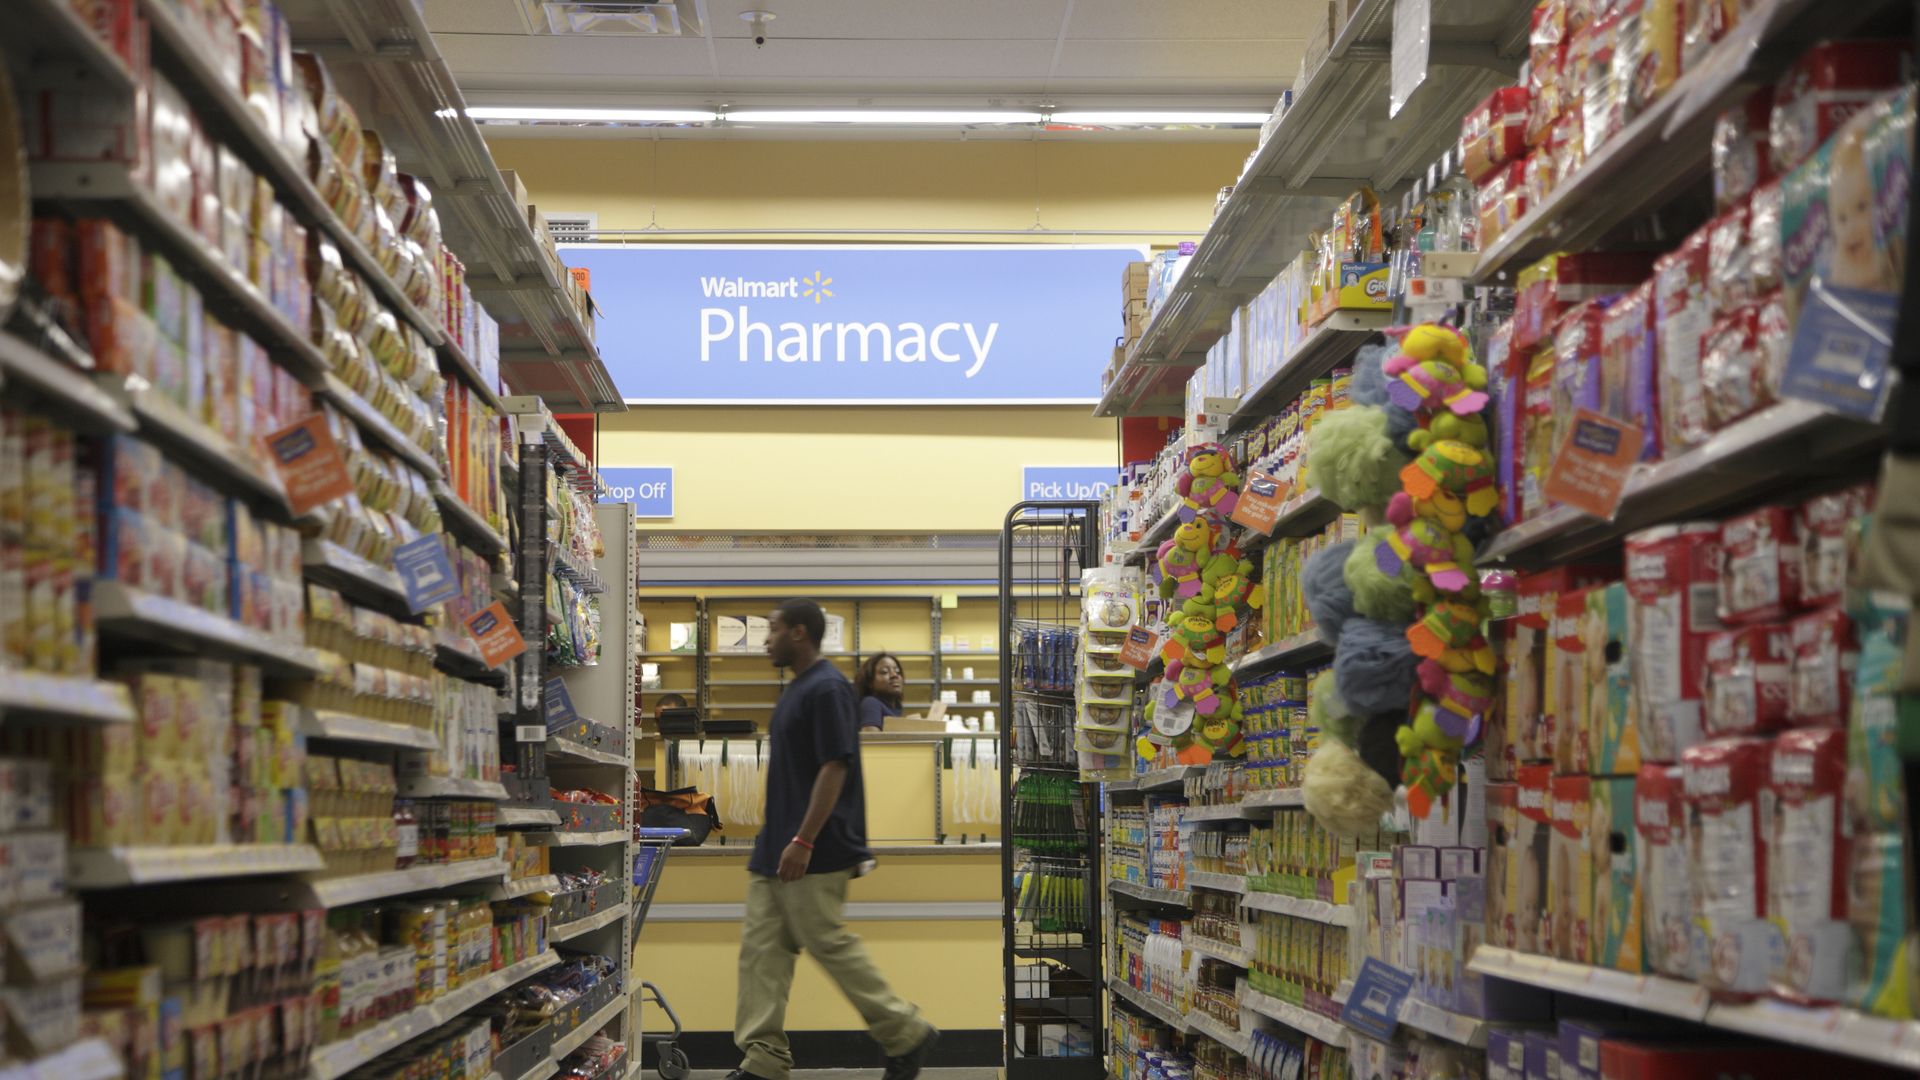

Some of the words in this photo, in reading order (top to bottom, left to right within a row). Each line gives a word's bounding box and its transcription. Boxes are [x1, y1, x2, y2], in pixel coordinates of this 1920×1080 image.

[700, 276, 798, 298] Walmart
[701, 306, 999, 378] Pharmacy
[598, 485, 635, 503] rop
[639, 482, 666, 499] Off
[1030, 482, 1062, 498] Pick
